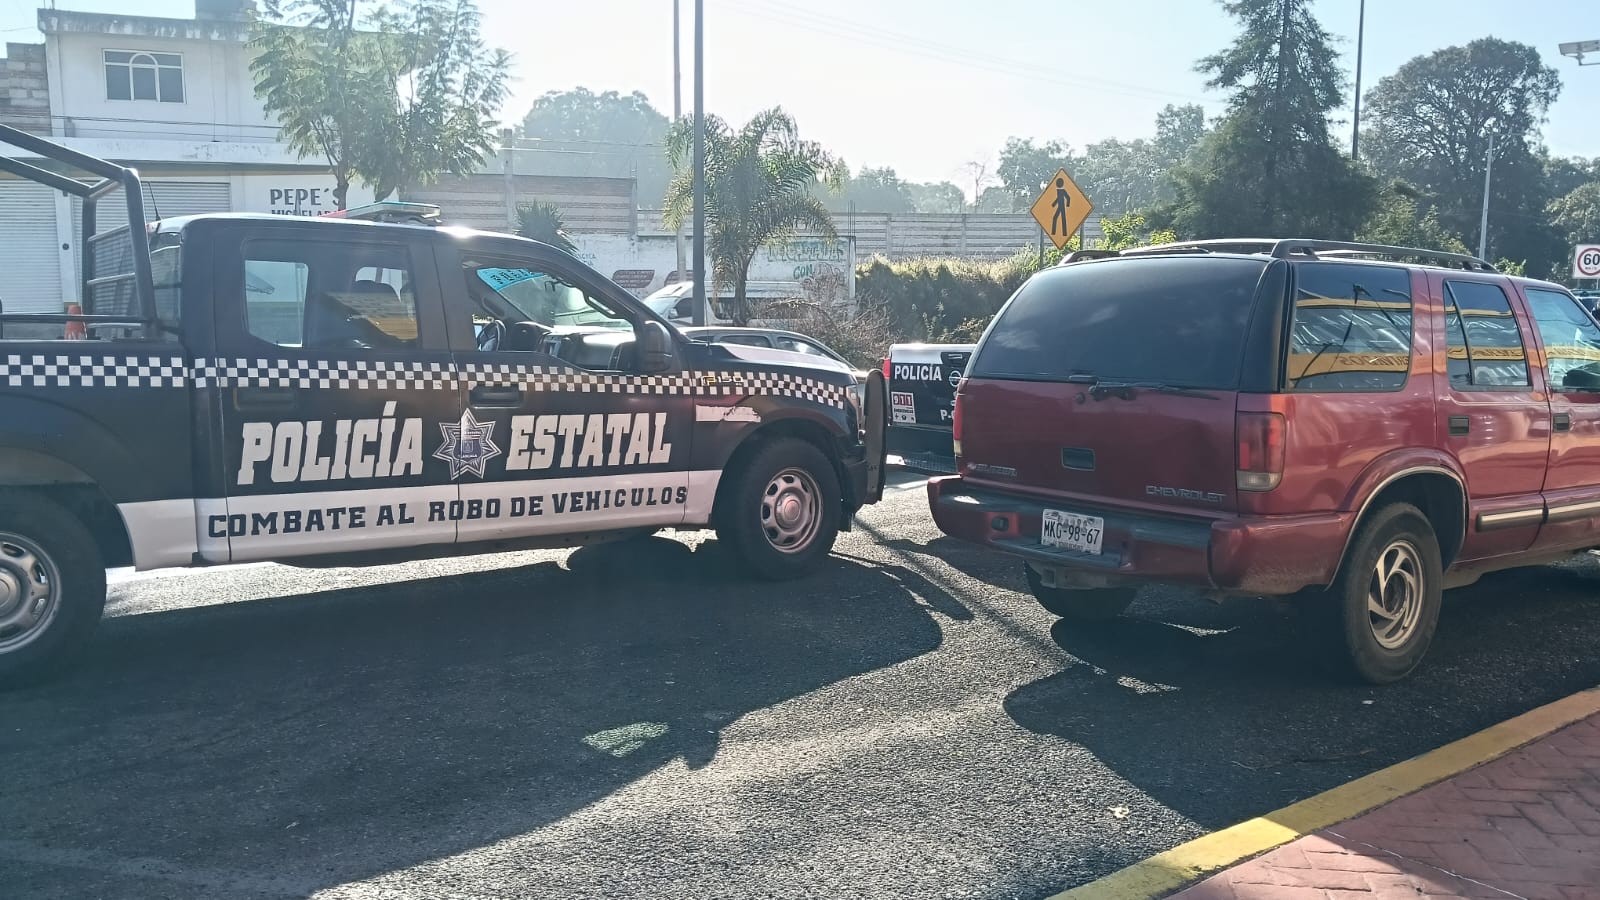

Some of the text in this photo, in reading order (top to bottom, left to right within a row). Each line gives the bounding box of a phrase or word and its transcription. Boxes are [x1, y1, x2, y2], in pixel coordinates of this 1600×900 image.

[1583, 253, 1600, 266] 60
[893, 394, 913, 406] 911
[237, 400, 672, 486] POLICÍA ESTATAL
[1145, 485, 1226, 502] CHEVROLET
[208, 486, 688, 538] COMBATE AL ROBO DE VEHICULOS
